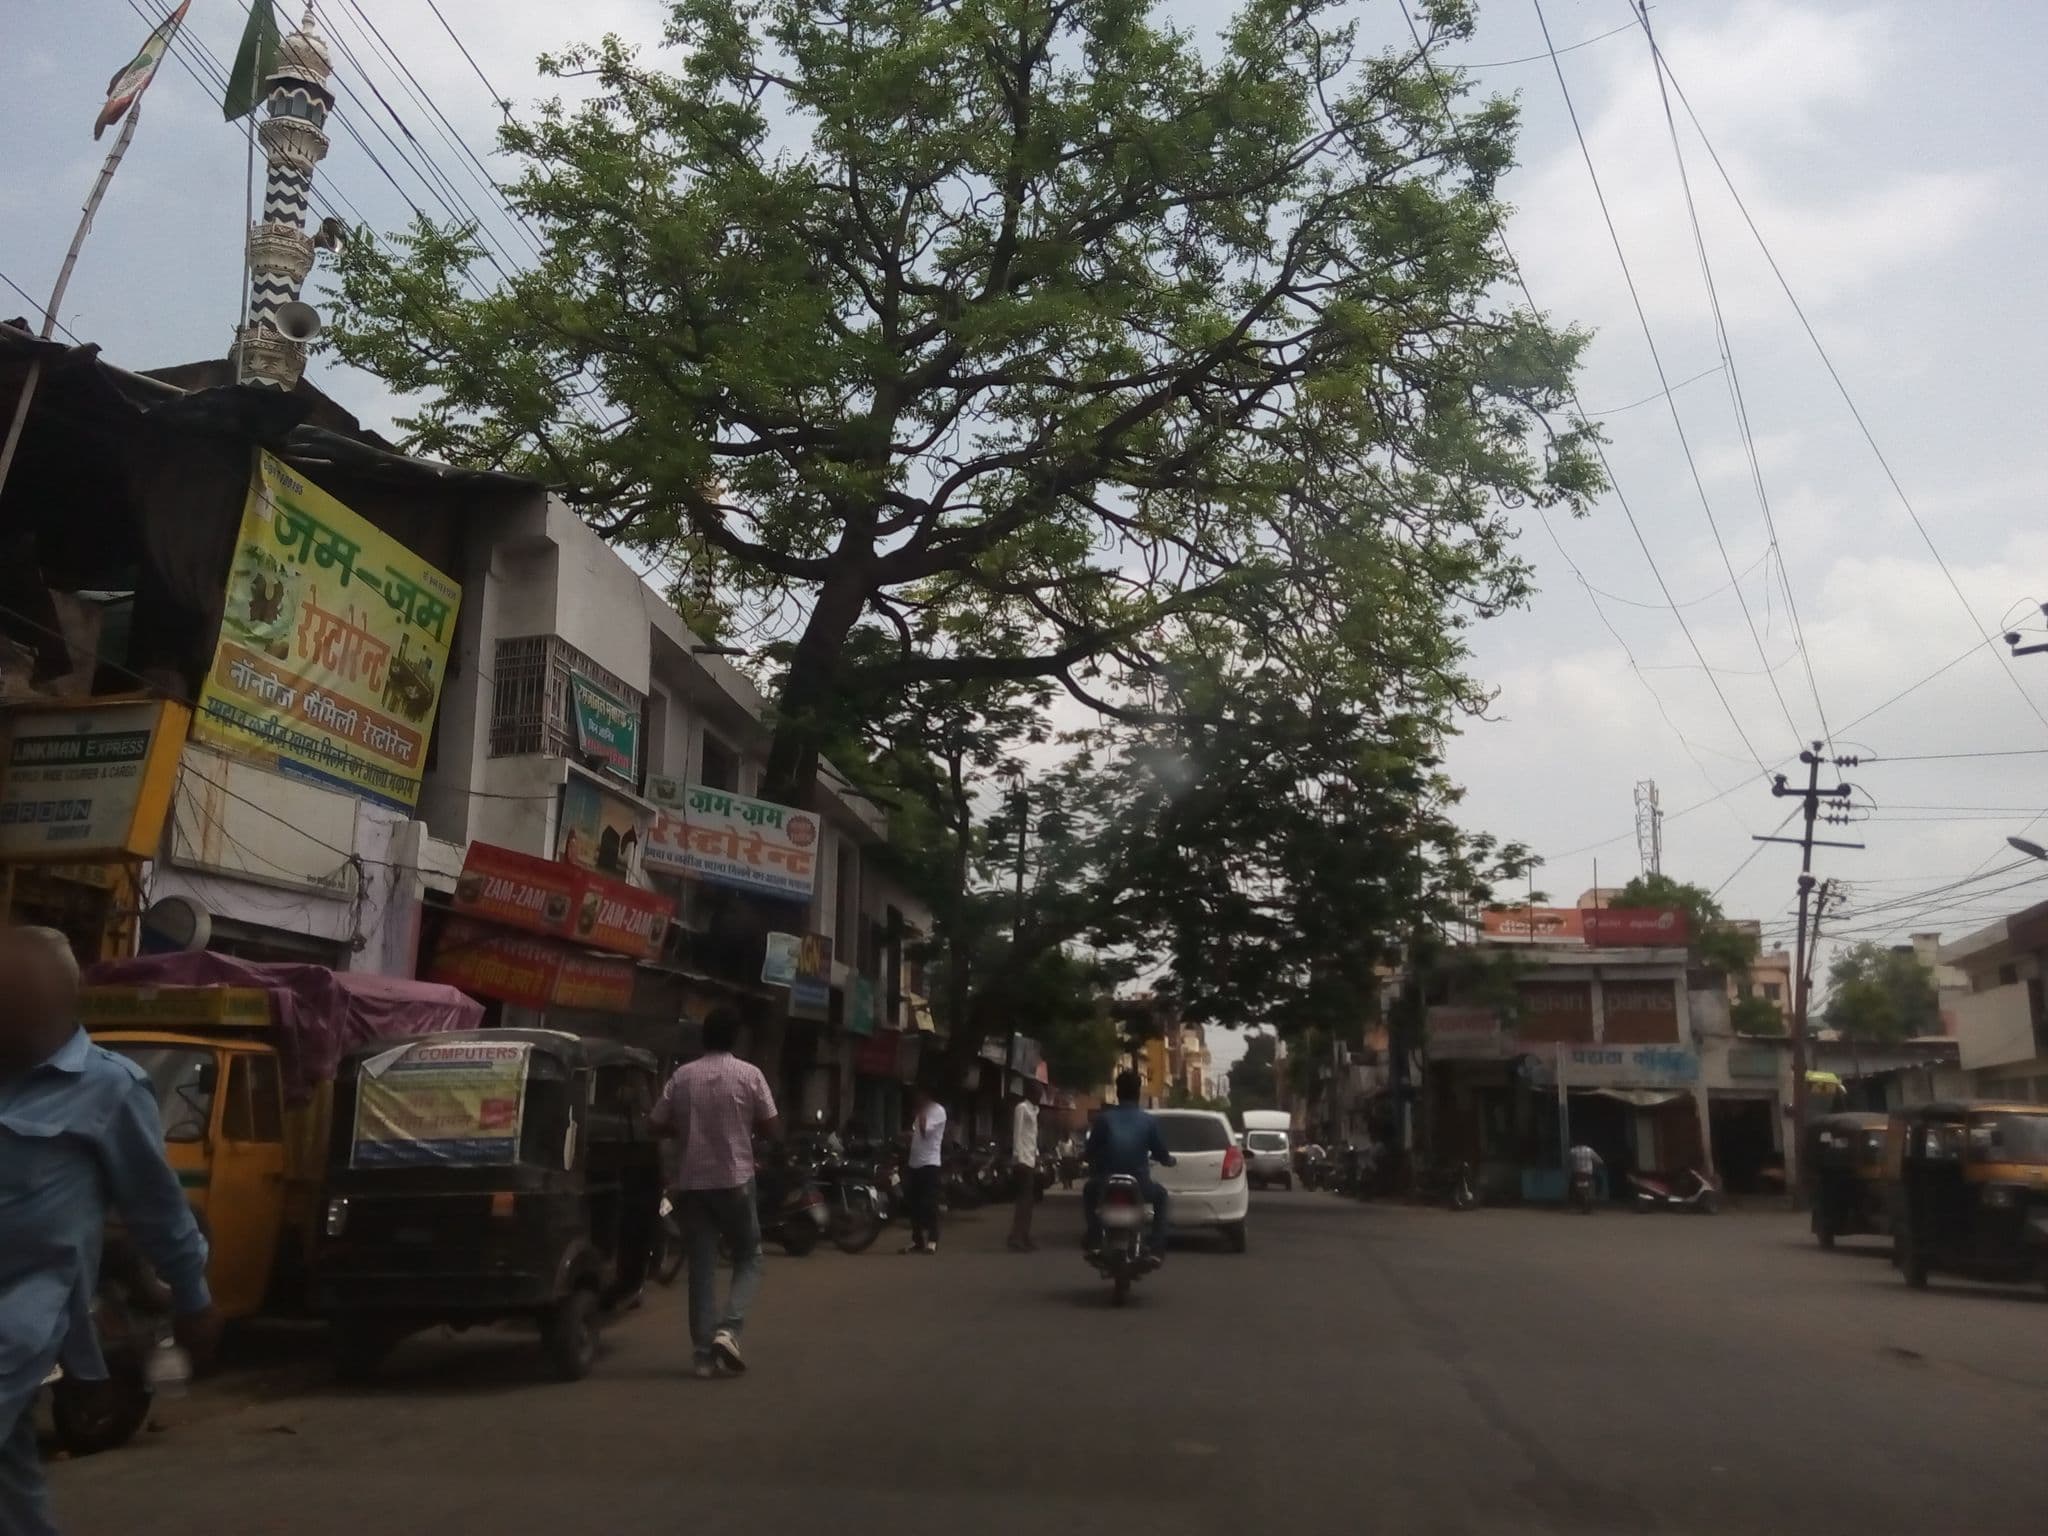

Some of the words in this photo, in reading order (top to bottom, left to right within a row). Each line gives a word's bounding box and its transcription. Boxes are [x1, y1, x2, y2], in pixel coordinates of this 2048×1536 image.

[274, 498, 451, 641] ज़म-ज़म
[14, 742, 80, 760] LINKMAN
[109, 765, 136, 778] CARGO
[688, 789, 785, 828] ज़म-ज़म
[483, 876, 546, 912] ZAM-ZAM
[598, 900, 652, 938] ZAM-ZAM
[1608, 988, 1673, 1015] paints
[418, 1047, 518, 1060] COMPUTERS
